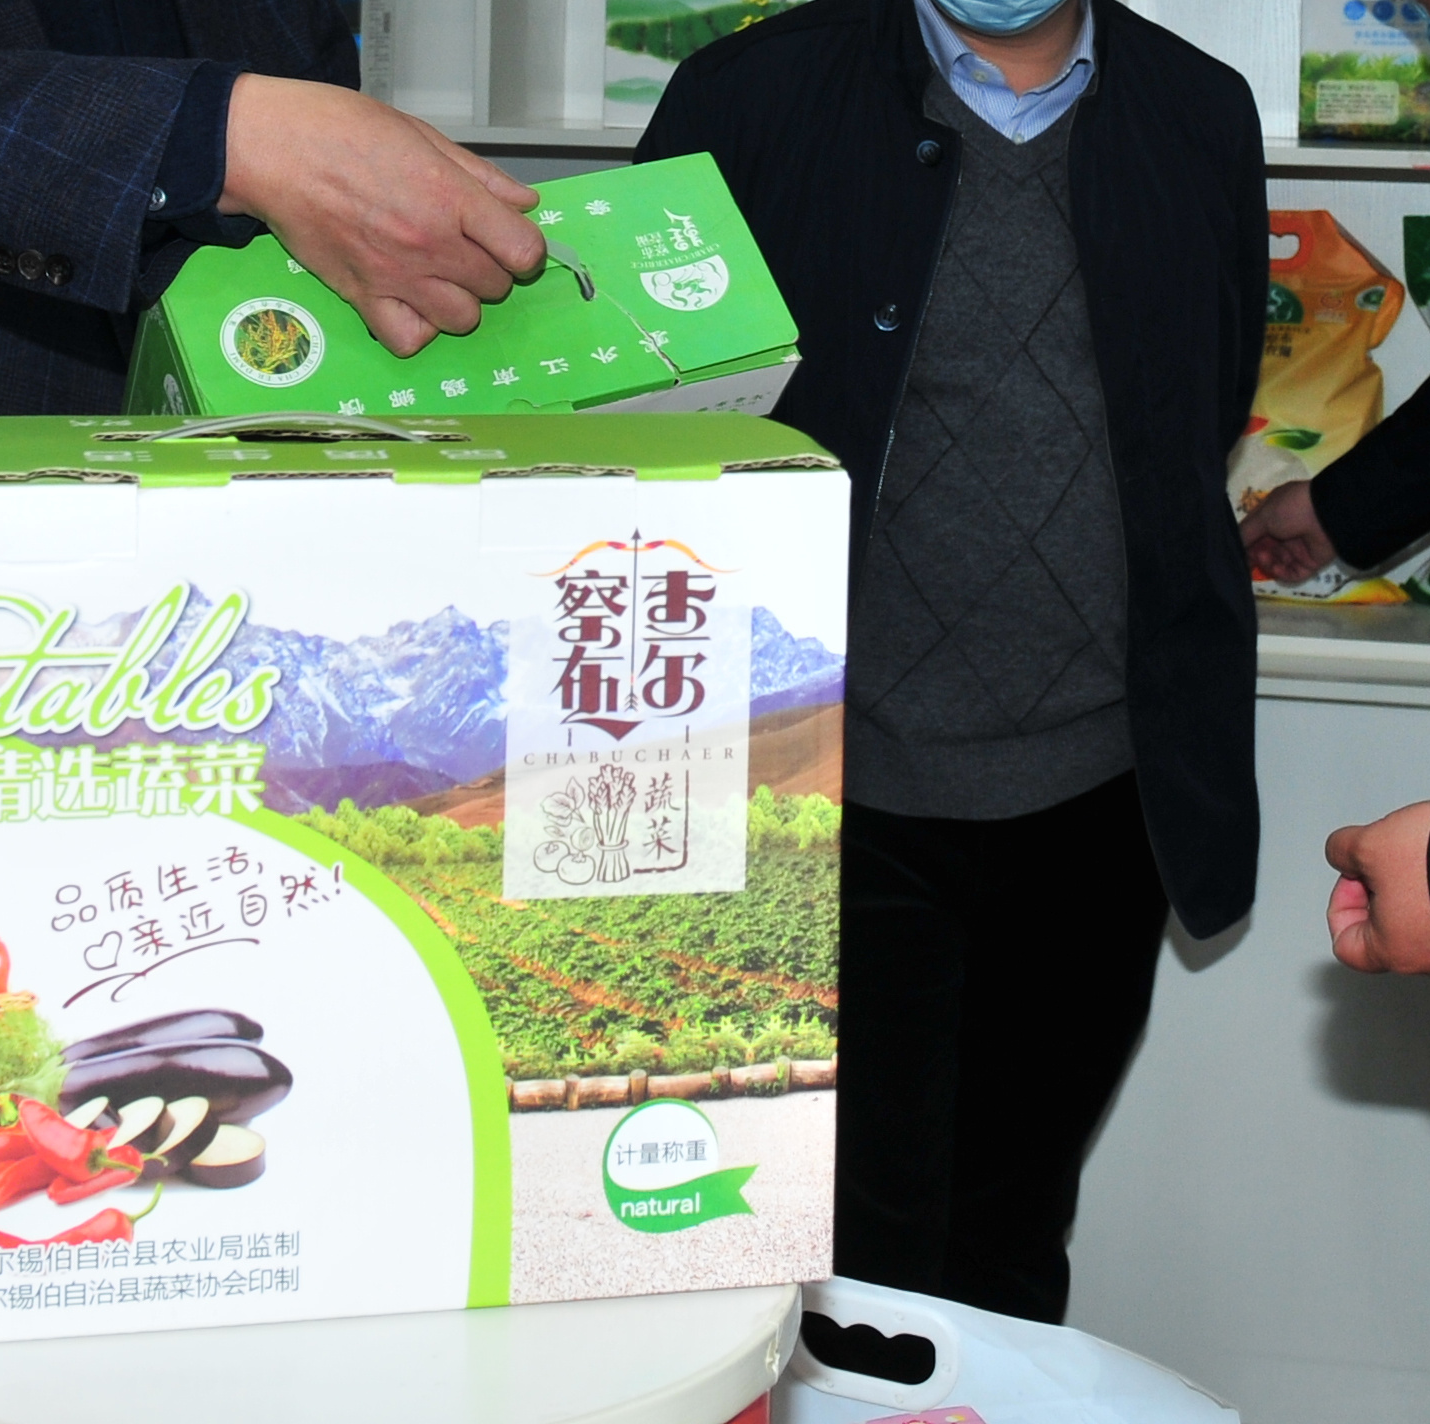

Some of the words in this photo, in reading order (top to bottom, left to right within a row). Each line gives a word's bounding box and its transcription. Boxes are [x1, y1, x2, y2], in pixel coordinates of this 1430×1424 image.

[643, 771, 680, 861] 蔬菜
[616, 1139, 708, 1166] 计量称重
[621, 1192, 701, 1218] natural
